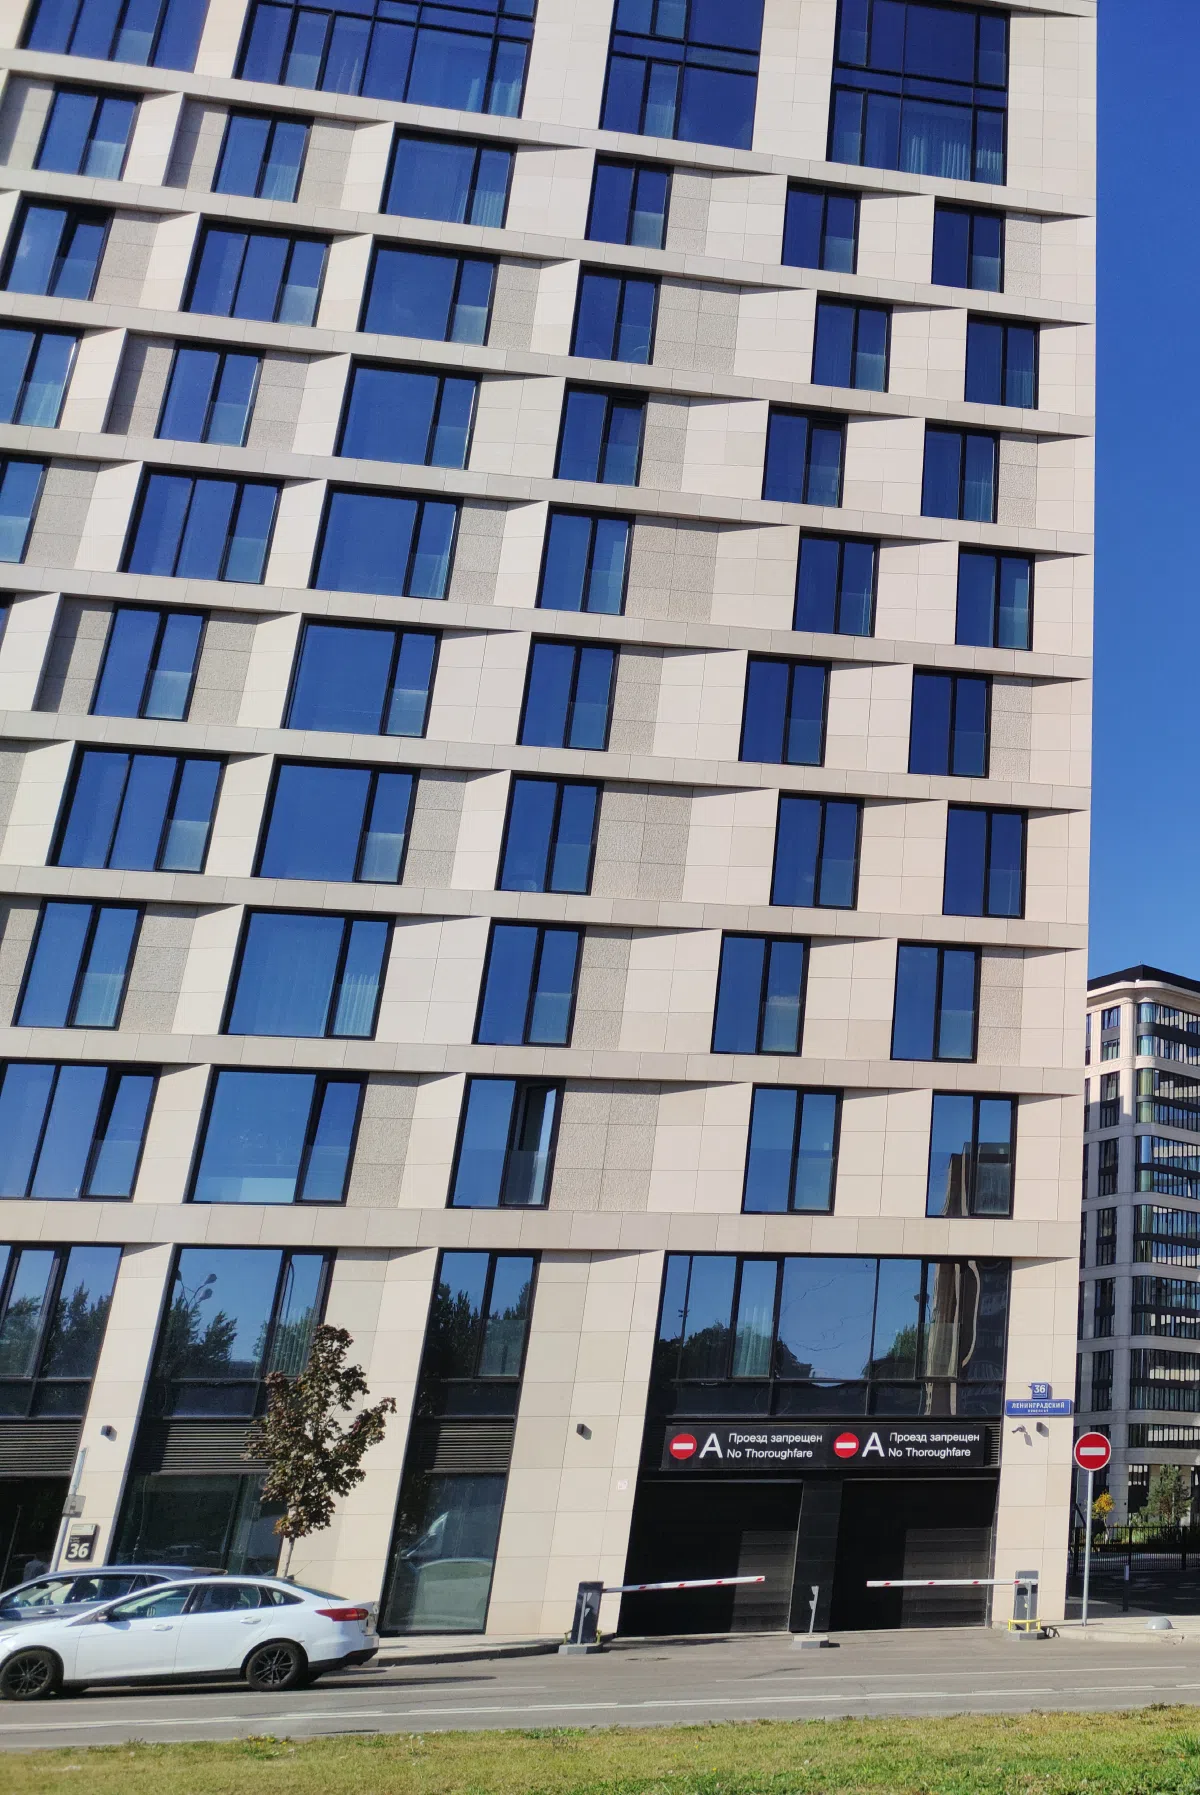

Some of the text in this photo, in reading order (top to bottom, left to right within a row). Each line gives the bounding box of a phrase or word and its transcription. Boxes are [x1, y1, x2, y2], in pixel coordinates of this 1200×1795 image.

[1033, 1384, 1046, 1394] 36
[728, 1433, 823, 1444] Проезд запрещен
[889, 1432, 980, 1443] Проезд запрещен
[727, 1448, 813, 1461] No Thoroughfare
[888, 1447, 971, 1459] No Thoroughfare
[67, 1542, 90, 1559] 36
